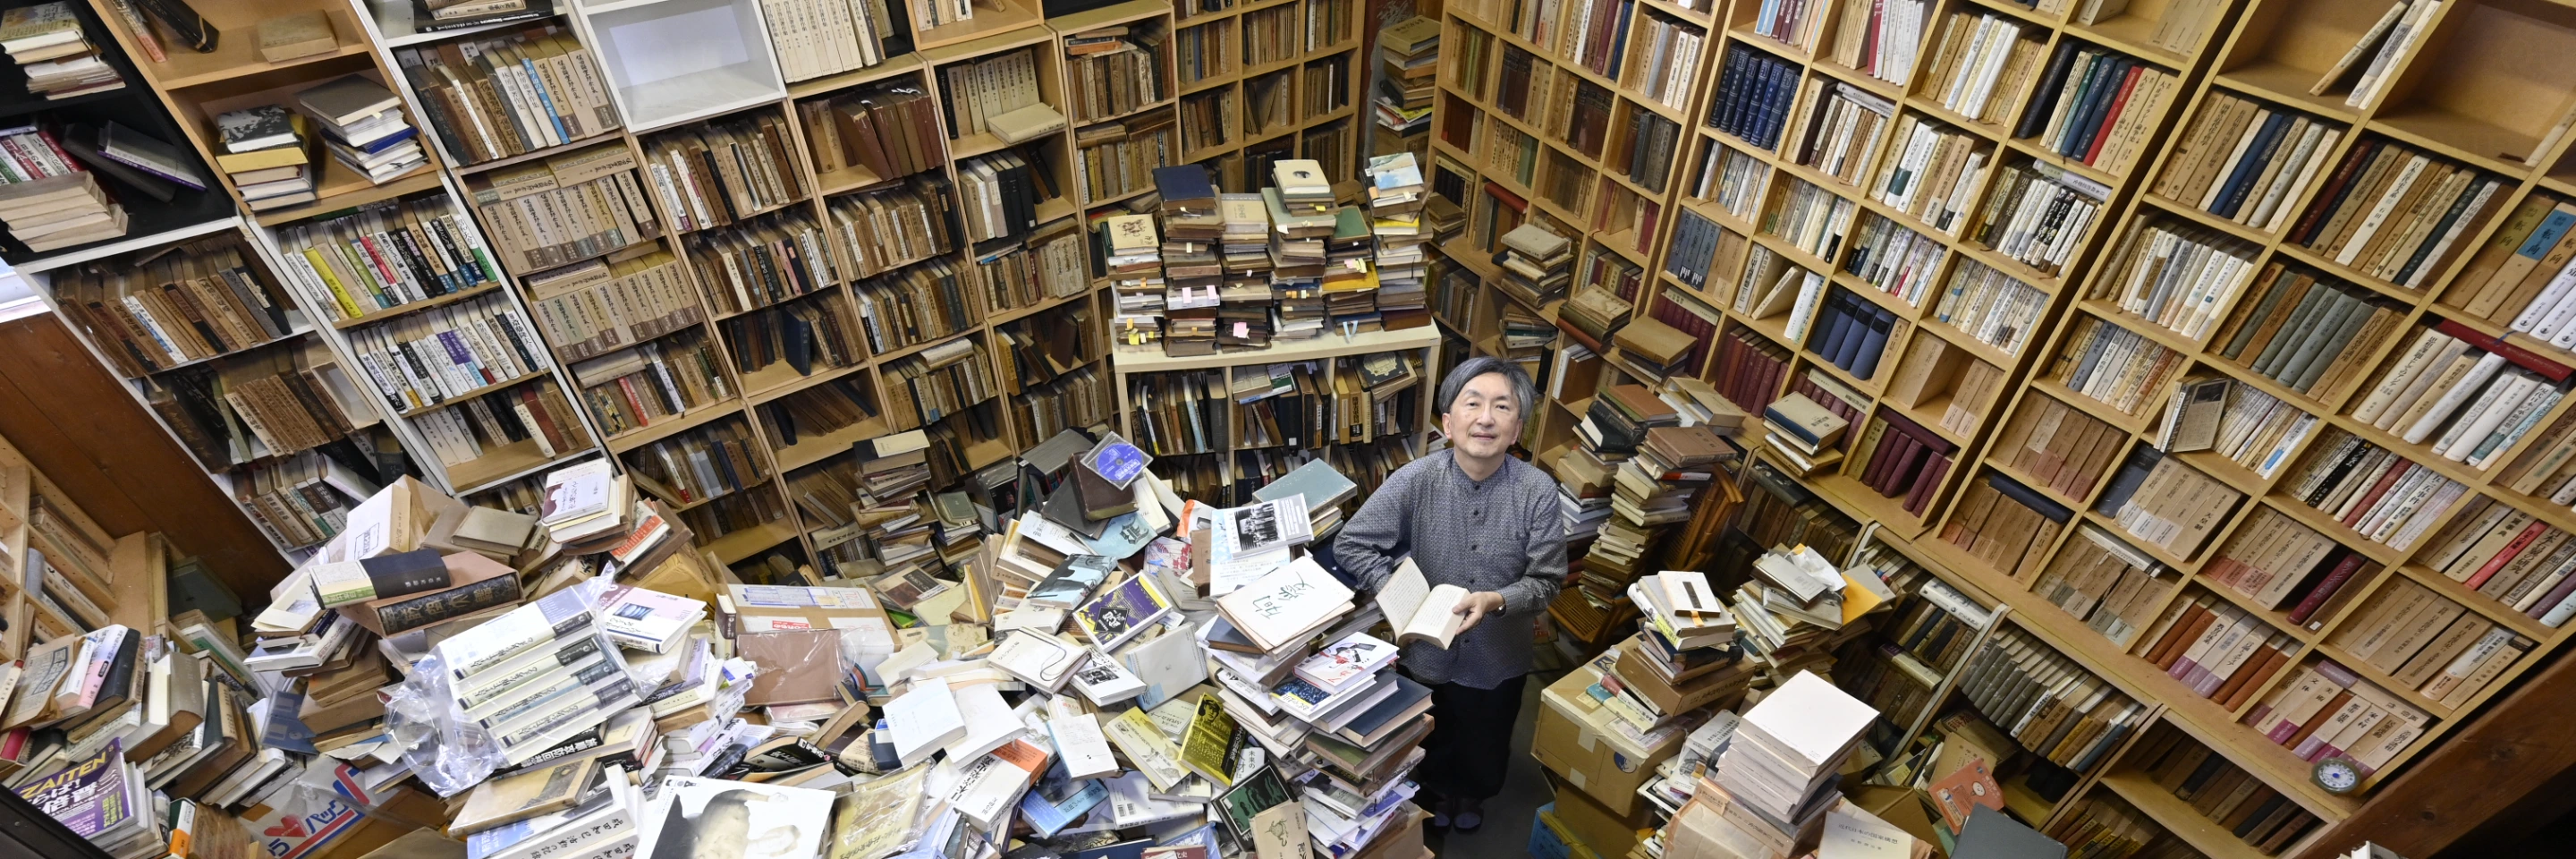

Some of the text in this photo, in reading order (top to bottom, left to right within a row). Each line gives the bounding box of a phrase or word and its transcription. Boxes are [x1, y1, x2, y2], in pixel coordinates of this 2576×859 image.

[556, 59, 581, 99] 保田與重郎全集
[575, 54, 597, 94] 保田與重郎全集
[514, 69, 539, 108] 林房雄著作集
[2498, 220, 2527, 246] 転向
[2526, 227, 2555, 255] 転向
[2547, 236, 2576, 265] 転向
[2193, 511, 2214, 532] 天皇制
[2496, 511, 2529, 538] 右翼事典
[2508, 527, 2563, 574] 日本右翼の研究
[2201, 622, 2224, 644] 教育の体系
[2301, 676, 2319, 693] 文体
[2315, 686, 2334, 702] 美術
[2356, 711, 2378, 728] 家と村
[20, 752, 106, 799] ZAITEN
